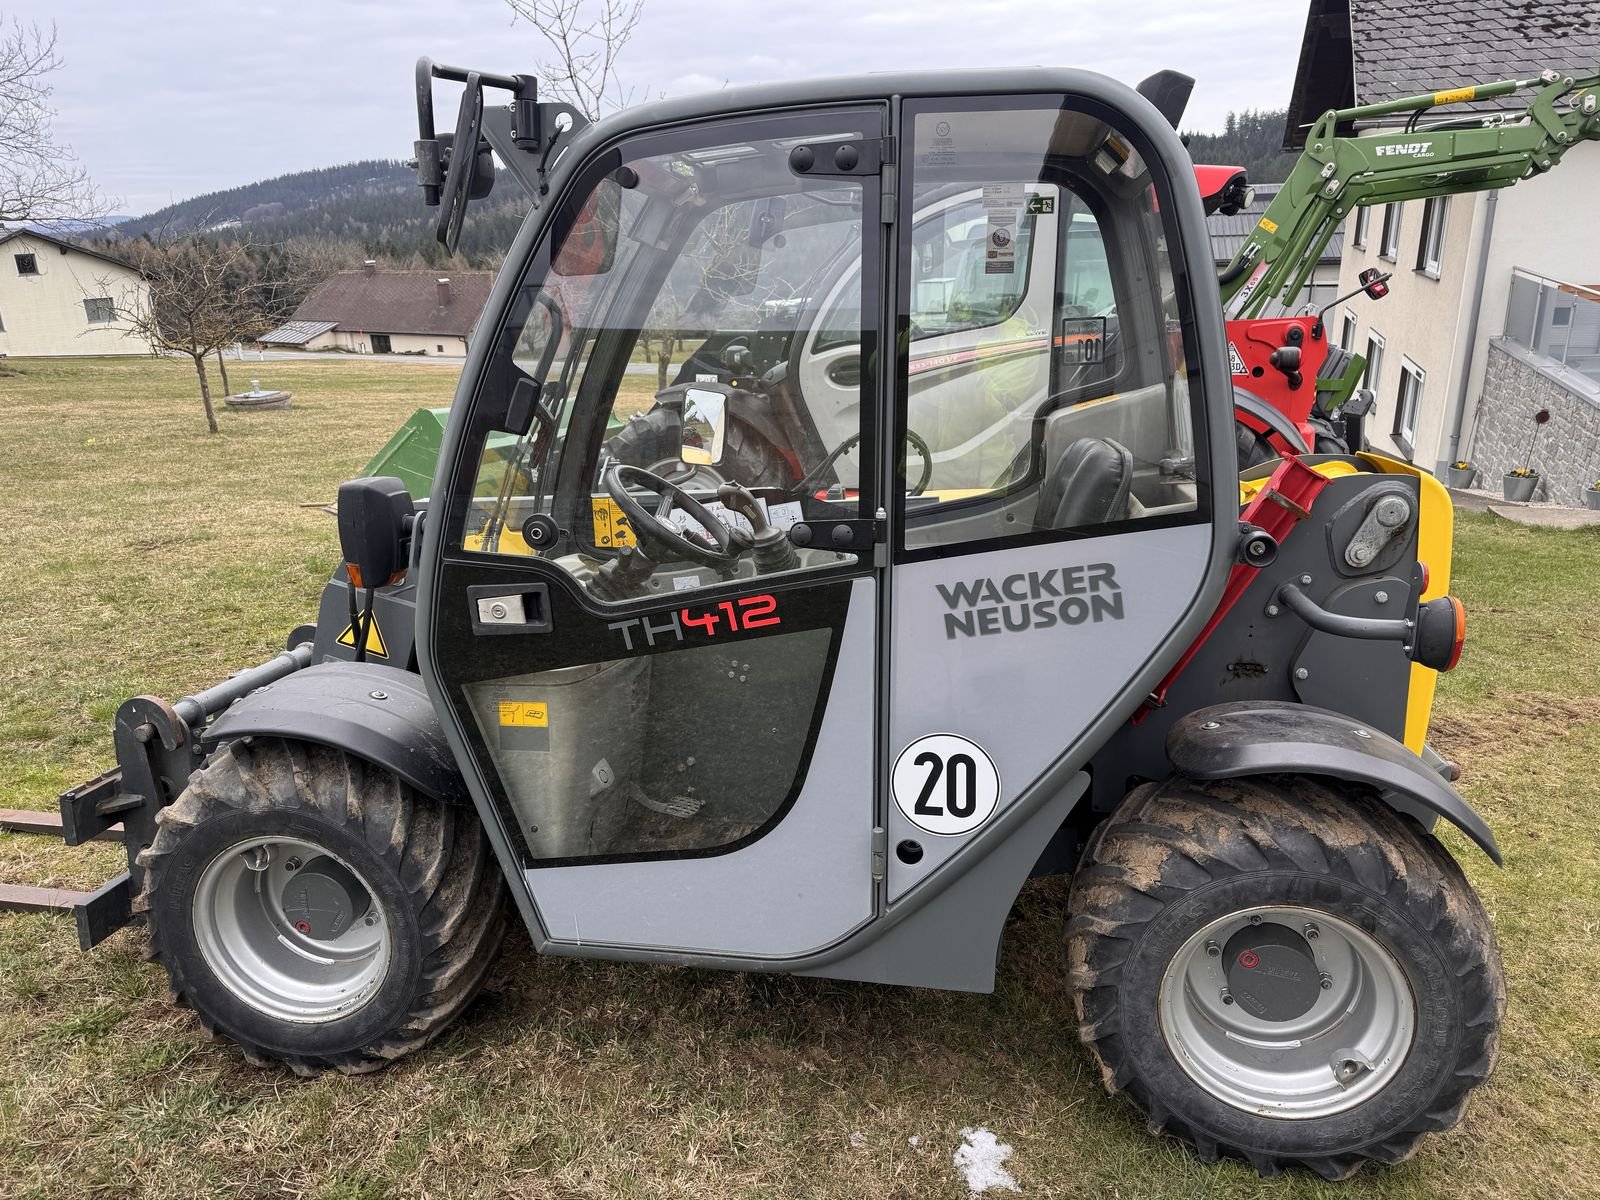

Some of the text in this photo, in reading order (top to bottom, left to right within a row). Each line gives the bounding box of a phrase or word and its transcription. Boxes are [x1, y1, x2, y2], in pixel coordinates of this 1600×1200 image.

[1375, 142, 1432, 157] FENDT
[935, 562, 1122, 609] WACKER
[607, 594, 781, 650] TH412
[944, 592, 1125, 640] NEUSON
[913, 751, 977, 818] 20
